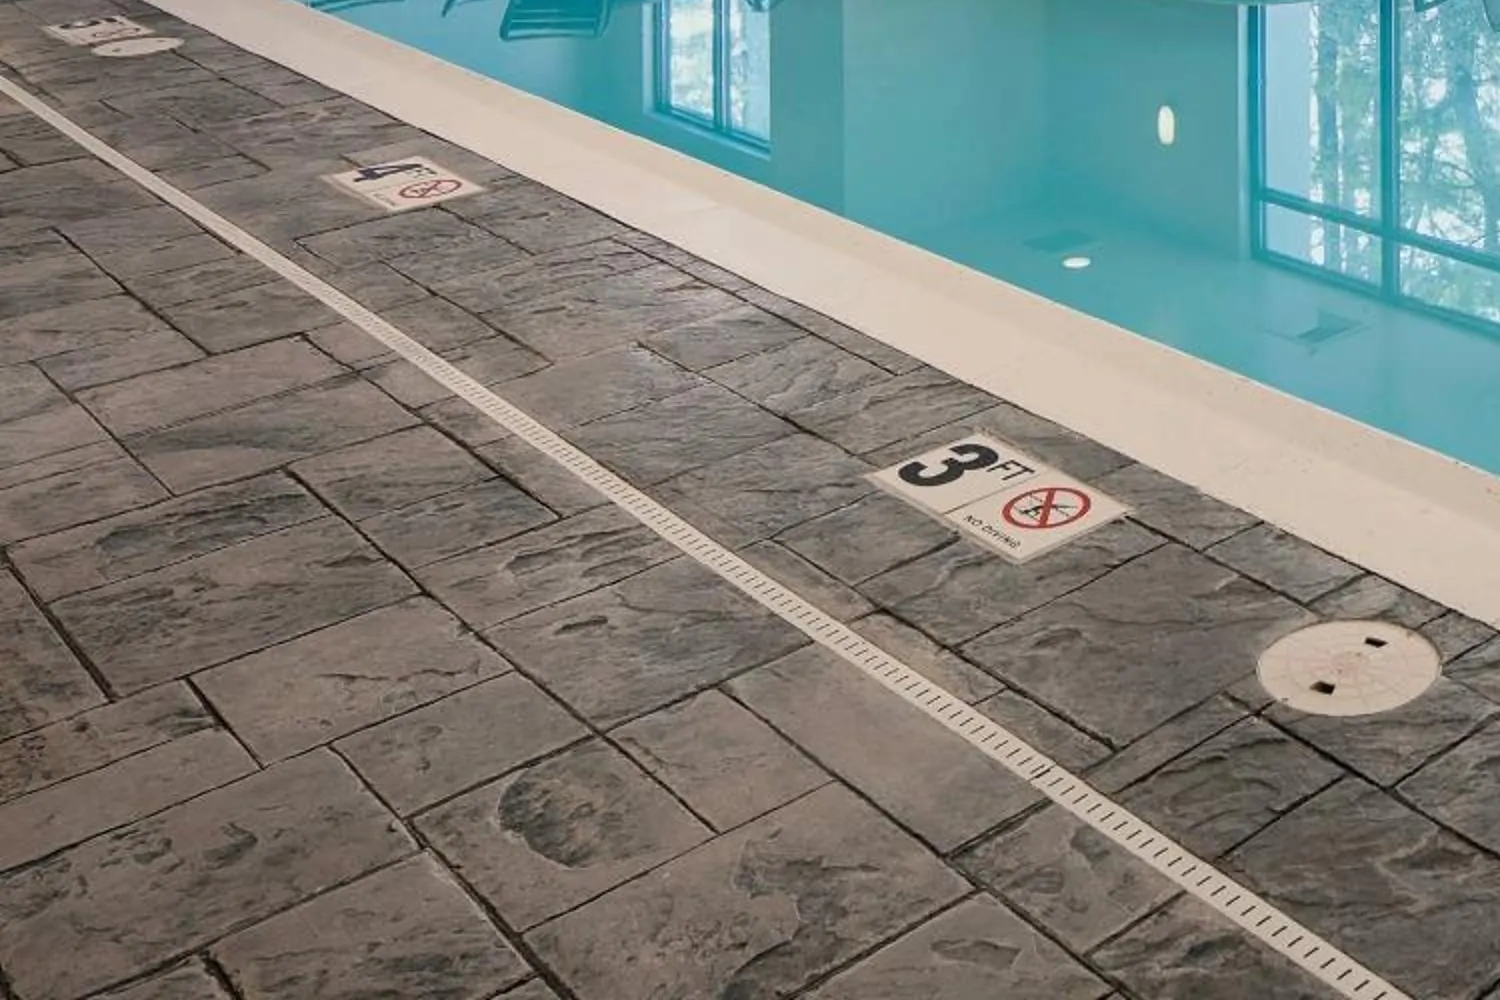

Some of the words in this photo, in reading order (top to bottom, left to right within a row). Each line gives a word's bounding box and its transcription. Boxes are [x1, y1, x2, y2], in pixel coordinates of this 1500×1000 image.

[898, 443, 999, 487] 3
[986, 459, 1035, 481] FT
[963, 514, 983, 527] NO
[981, 522, 1022, 549] DIVING
